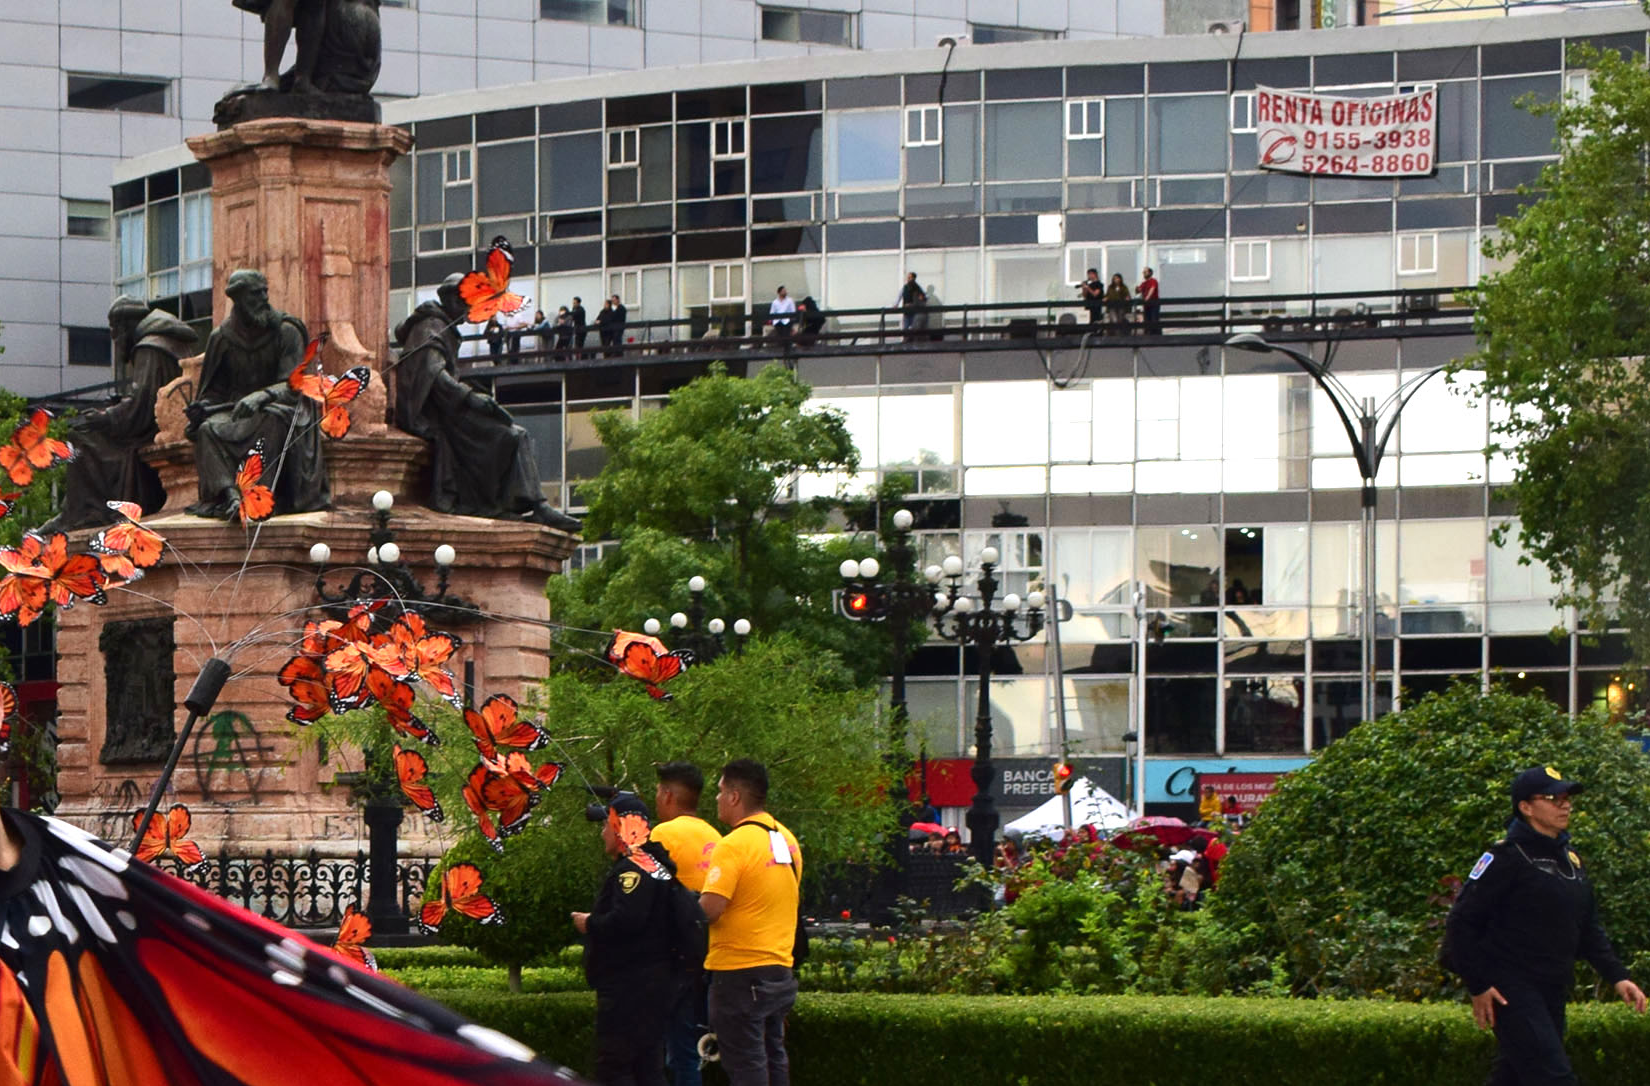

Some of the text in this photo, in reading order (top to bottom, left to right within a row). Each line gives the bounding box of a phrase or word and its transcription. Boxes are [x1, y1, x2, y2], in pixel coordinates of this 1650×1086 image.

[1258, 92, 1433, 127] RENTA OFICINAS
[1303, 128, 1431, 150] 9155-3938
[1302, 152, 1430, 174] 5264-8860
[1003, 770, 1055, 781] BANCA
